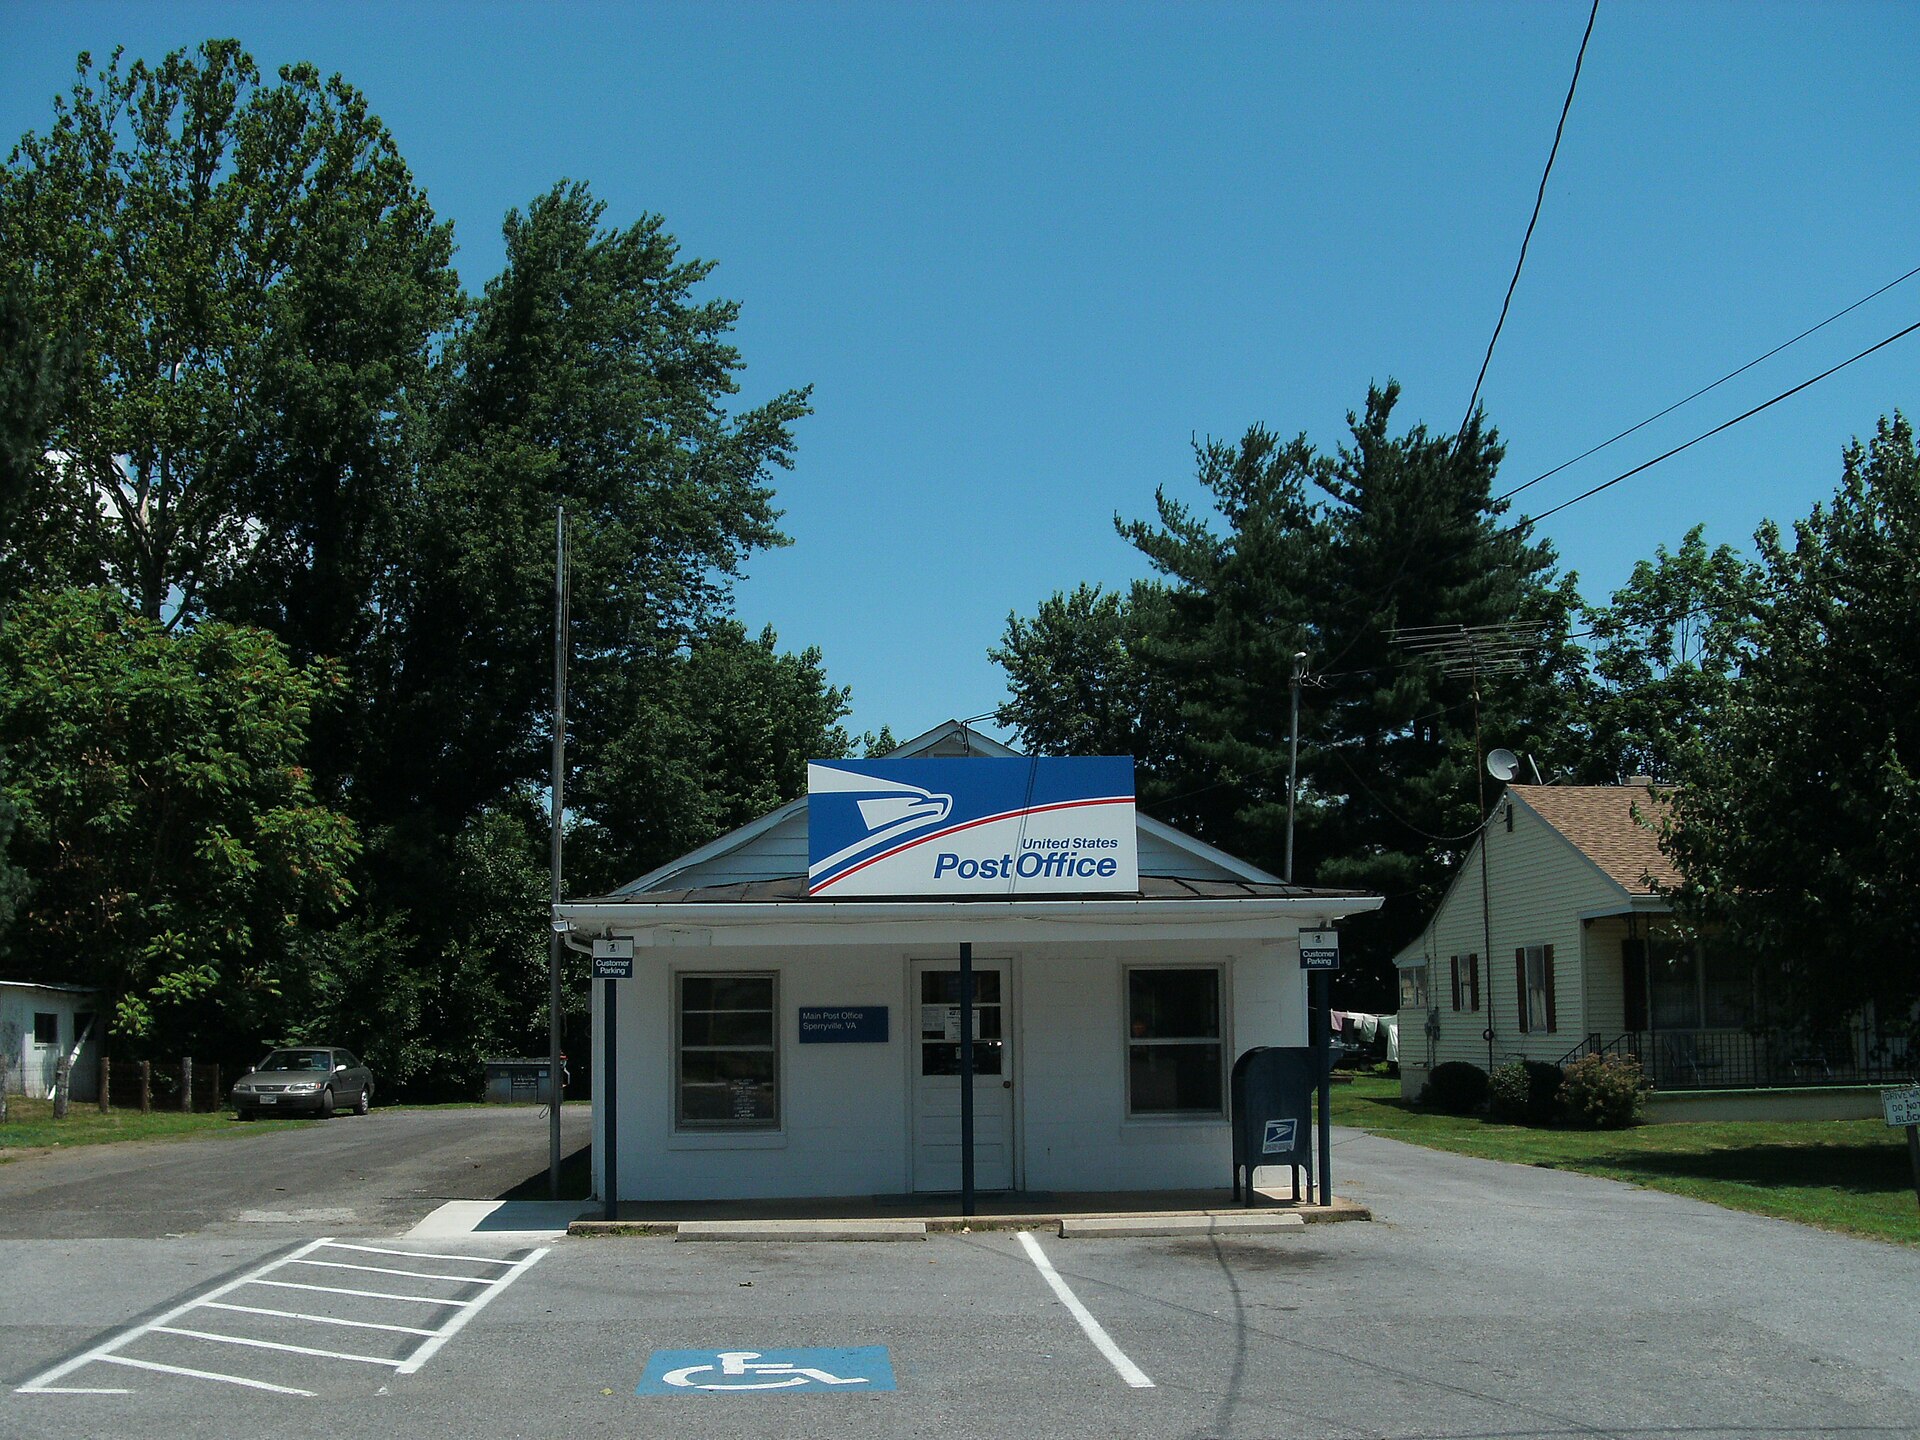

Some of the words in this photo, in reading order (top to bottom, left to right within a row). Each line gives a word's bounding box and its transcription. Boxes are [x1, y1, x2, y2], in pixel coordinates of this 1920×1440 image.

[1022, 838, 1070, 849] United
[1072, 837, 1119, 848] States
[933, 853, 1013, 879] Post
[1016, 852, 1118, 878] Office
[595, 959, 630, 967] Customer
[1307, 958, 1332, 966] Parking
[599, 967, 626, 975] Parking
[823, 1012, 840, 1020] Post
[841, 1011, 864, 1019] Office
[1884, 1090, 1920, 1101] DRIVEWA
[1892, 1104, 1903, 1112] DO
